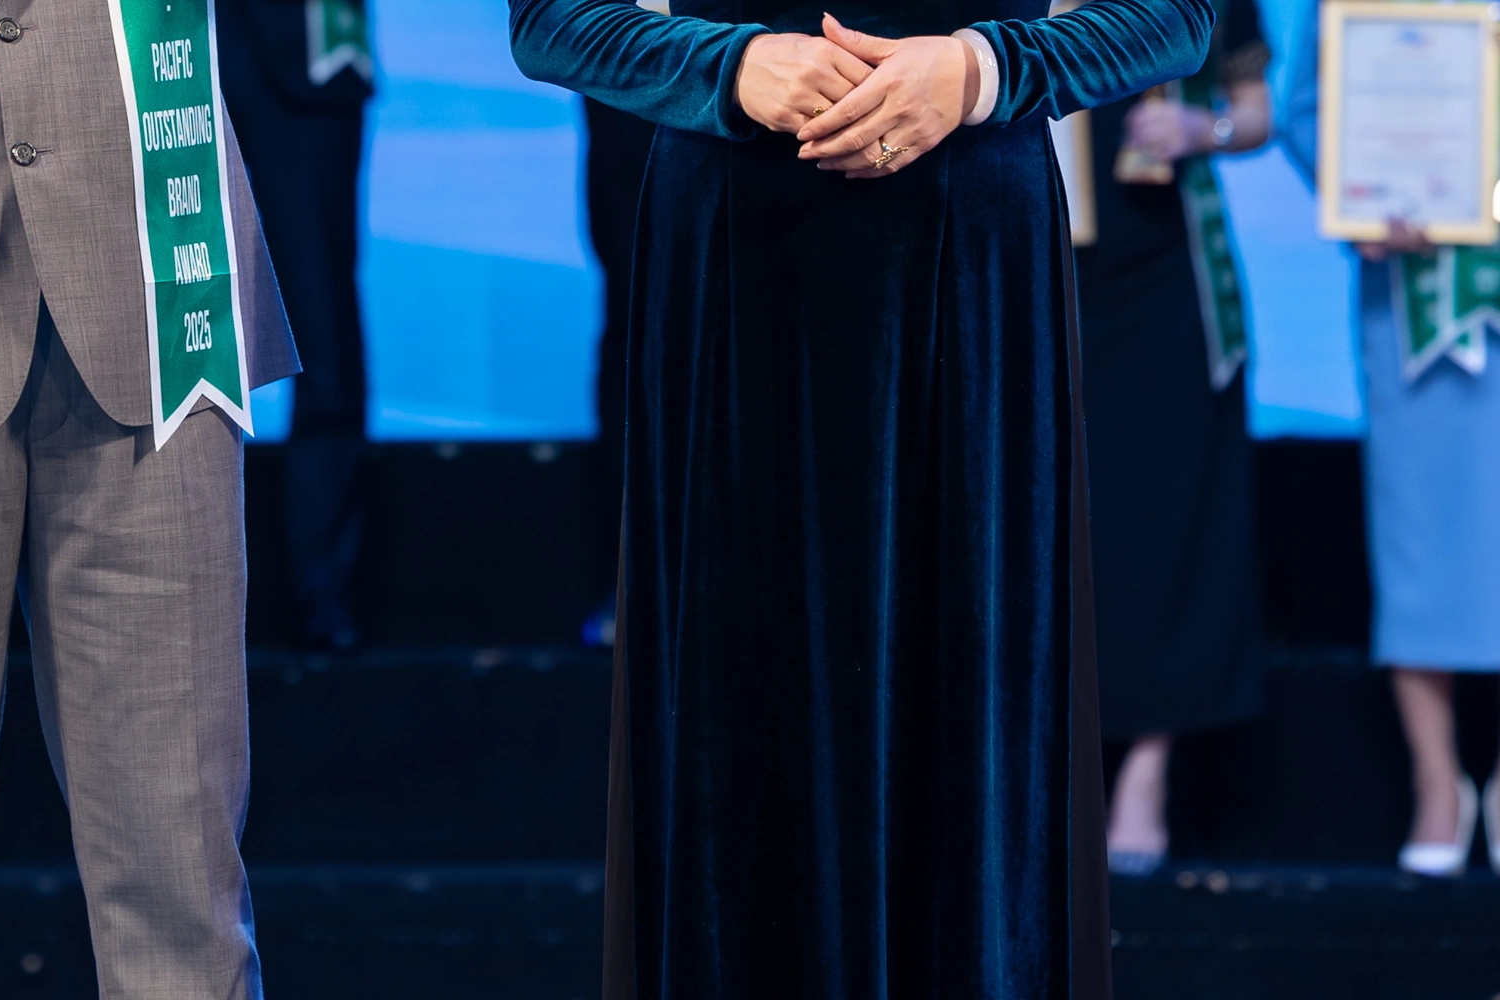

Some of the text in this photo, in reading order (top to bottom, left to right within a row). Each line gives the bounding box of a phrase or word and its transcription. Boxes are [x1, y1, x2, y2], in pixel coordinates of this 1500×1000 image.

[151, 38, 193, 82] PACIFIC
[143, 104, 213, 152] OUTSTANDING
[167, 174, 201, 217] BRAND
[174, 242, 211, 285] AWARD
[184, 310, 212, 352] 2025
